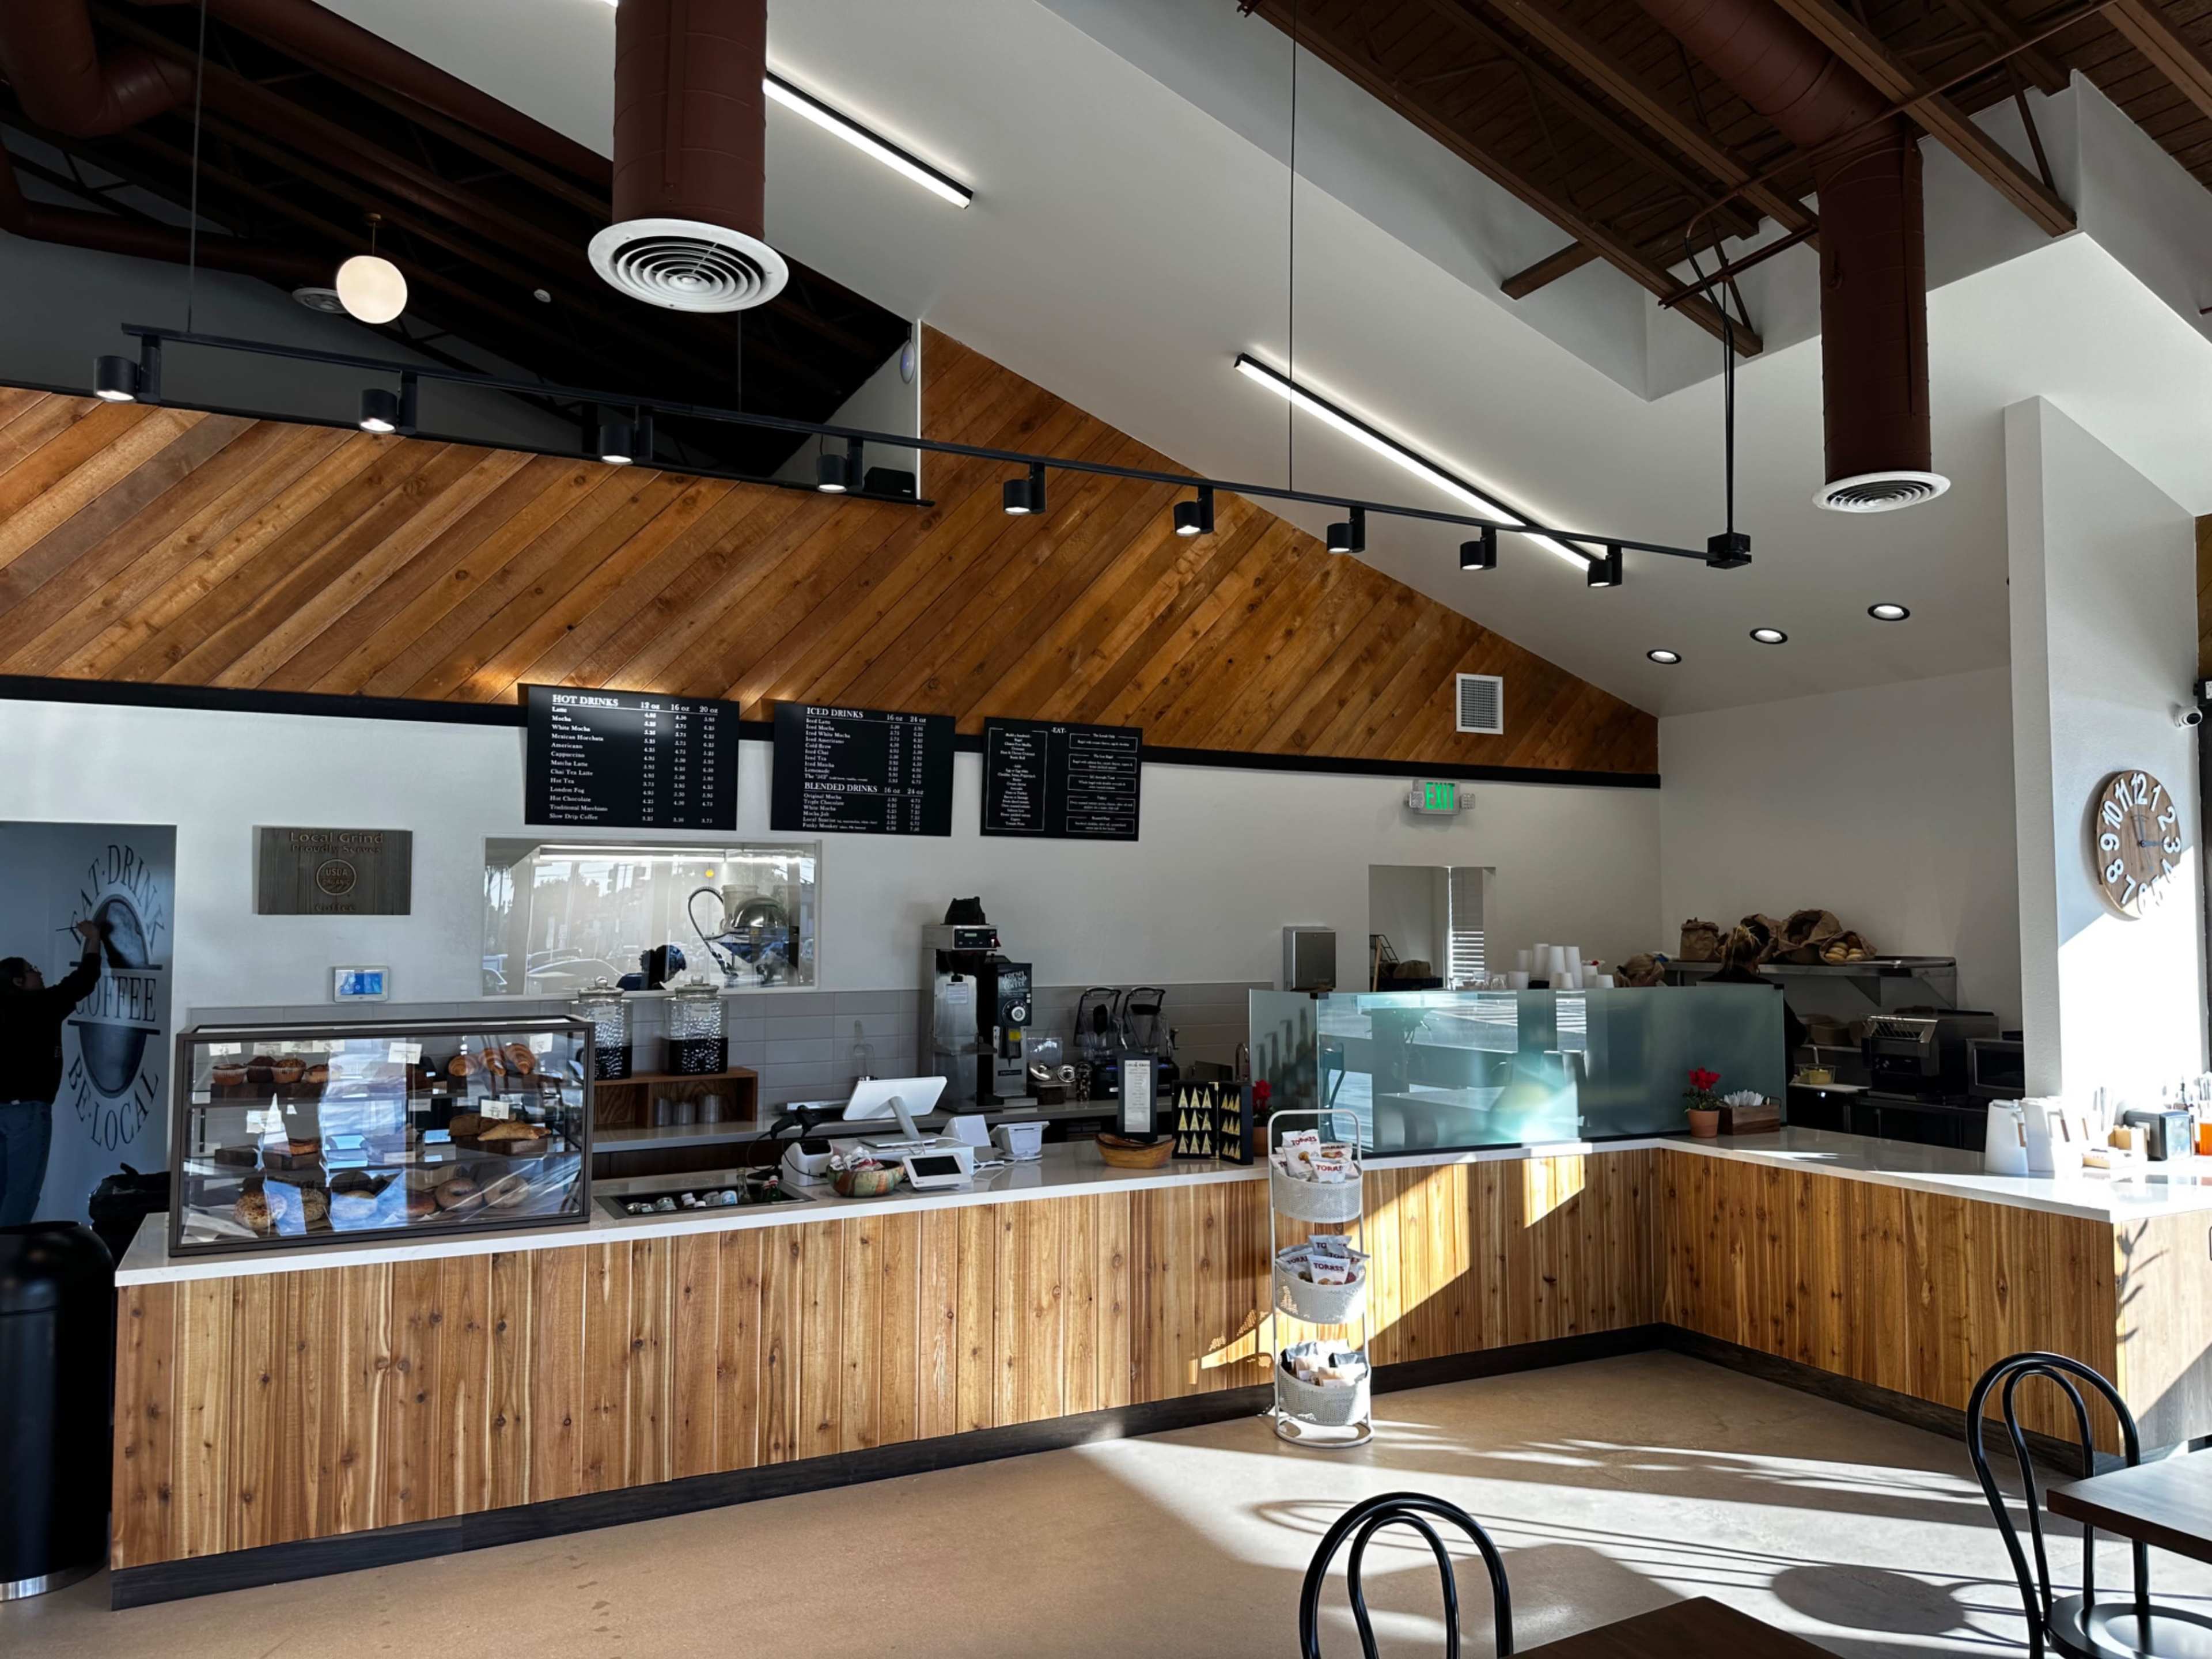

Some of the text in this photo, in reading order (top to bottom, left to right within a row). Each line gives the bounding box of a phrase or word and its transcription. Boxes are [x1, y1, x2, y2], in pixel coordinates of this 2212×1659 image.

[553, 695, 618, 706] HOT DRINKS
[807, 707, 863, 718] ICED DRINKS
[804, 782, 845, 791] BLENDED
[2115, 778, 2134, 812] 11
[2131, 773, 2147, 805] 12
[1426, 782, 1455, 810] EXIT
[2151, 784, 2161, 811] 1
[2102, 800, 2123, 830] 10
[2157, 806, 2176, 831] 2
[290, 831, 384, 843] Local Grind
[2100, 833, 2119, 851] 9
[2162, 836, 2181, 853] 3
[292, 844, 339, 853] Proudly
[326, 868, 347, 876] USDA
[2107, 858, 2124, 883] 8
[2121, 874, 2136, 904] 7
[315, 903, 356, 911] Coffee
[1291, 1136, 1317, 1146] TORRES
[1313, 1263, 1344, 1272] TORRES
